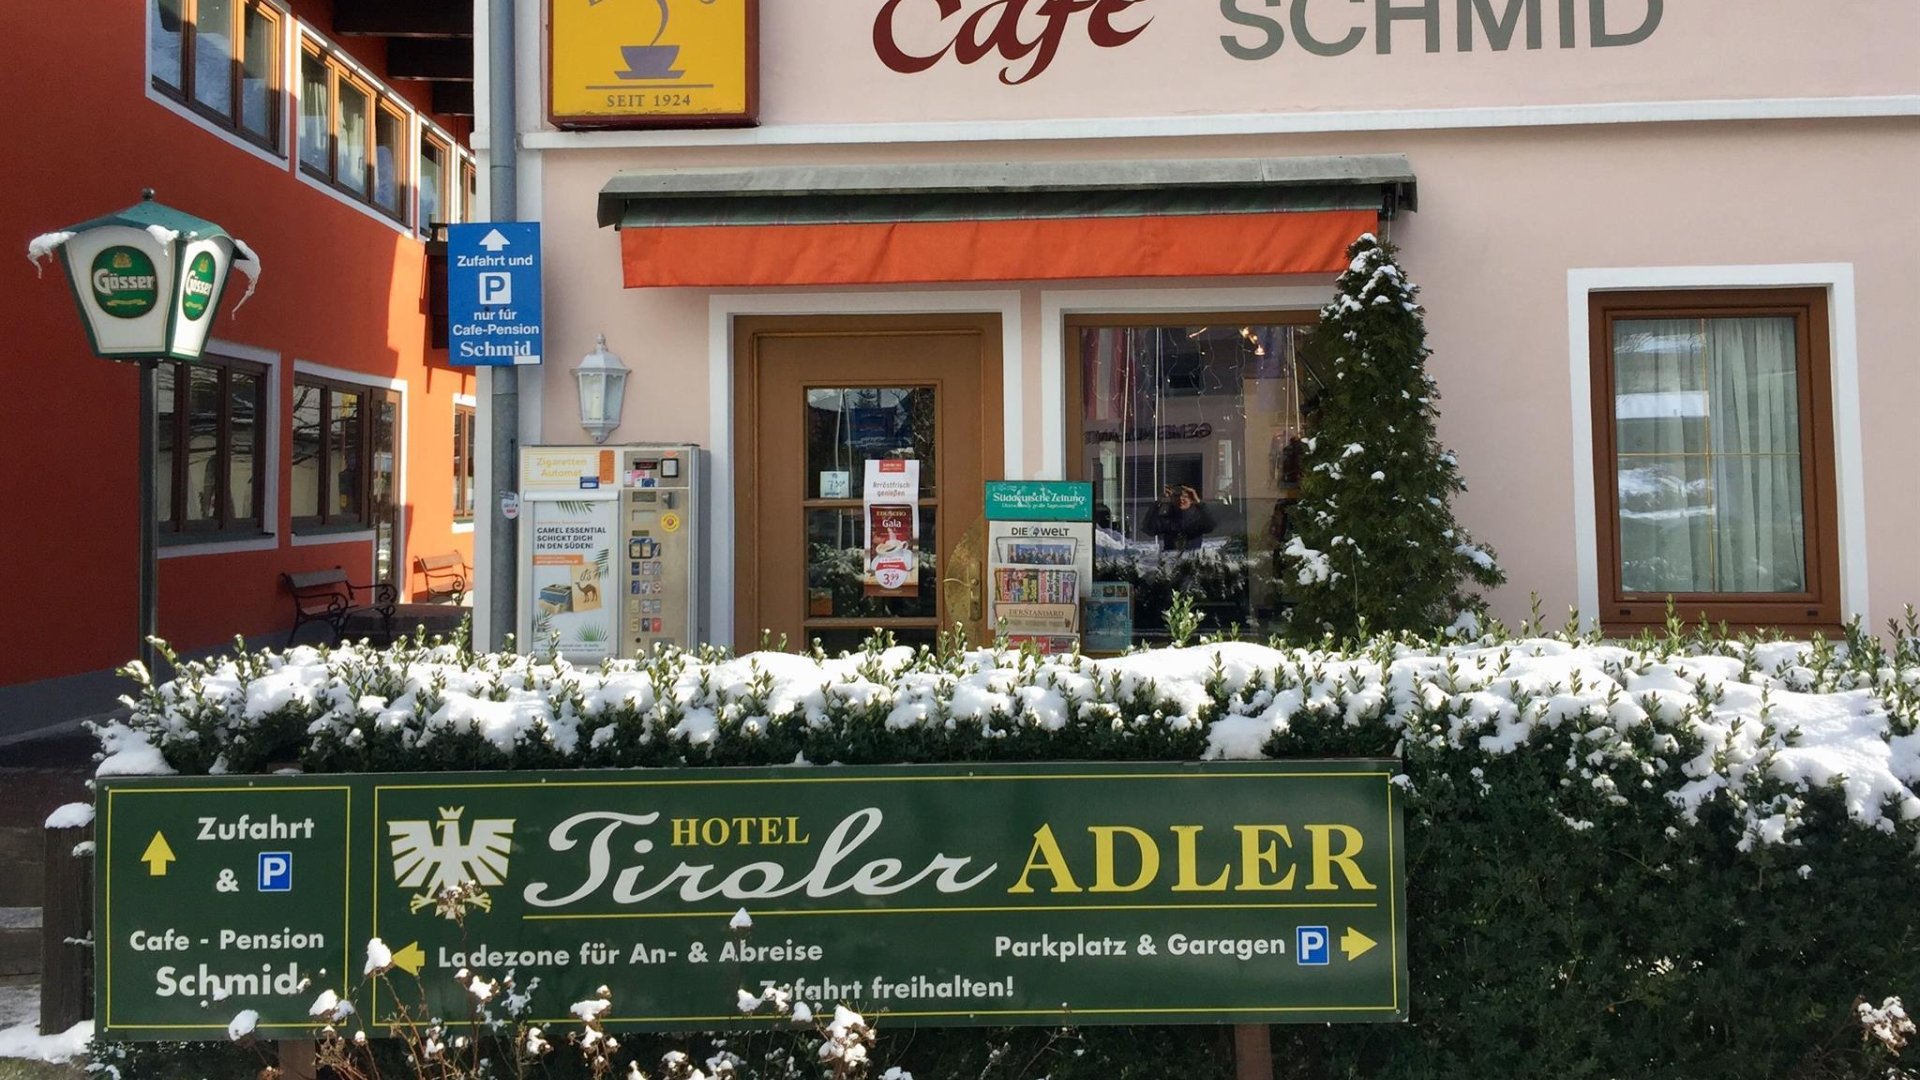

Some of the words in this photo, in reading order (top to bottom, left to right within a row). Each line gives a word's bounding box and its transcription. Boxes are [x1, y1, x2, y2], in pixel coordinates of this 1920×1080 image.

[1220, 0, 1664, 60] SCHMID
[607, 94, 645, 107] SEIT
[653, 94, 691, 107] 1924
[457, 255, 505, 267] Zufahrt
[509, 254, 533, 266] und
[93, 268, 155, 296] Gösser
[186, 269, 213, 296] Gösser
[485, 276, 506, 301] P
[474, 311, 495, 321] nur
[499, 308, 517, 321] für
[453, 323, 540, 336] Cafe-Pension
[460, 340, 531, 357] Schmid
[537, 457, 588, 467] Zigaretten
[541, 470, 582, 478] Automat
[1051, 492, 1085, 505] Zeitung
[882, 519, 901, 528] Gala
[1011, 527, 1028, 535] DIE
[565, 541, 594, 549] SÜDEN!
[197, 814, 315, 841] Zufahrt
[671, 816, 810, 847] HOTEL
[523, 807, 998, 907] Tiroler
[1007, 822, 1377, 894] ADLER
[216, 868, 239, 892] &
[263, 857, 286, 886] P
[130, 928, 190, 951] Cafe
[220, 928, 324, 950] Pension
[995, 935, 1127, 962] Parkplatz
[1137, 935, 1158, 956] &
[1167, 933, 1286, 961] Garagen
[1303, 932, 1324, 958] P
[439, 943, 570, 968] Ladezone
[579, 942, 619, 966] für
[630, 941, 677, 966] An-
[688, 941, 709, 964] &
[719, 938, 824, 963] Abreise
[156, 962, 298, 997] Schmid
[871, 974, 1015, 1000] freihalten!
